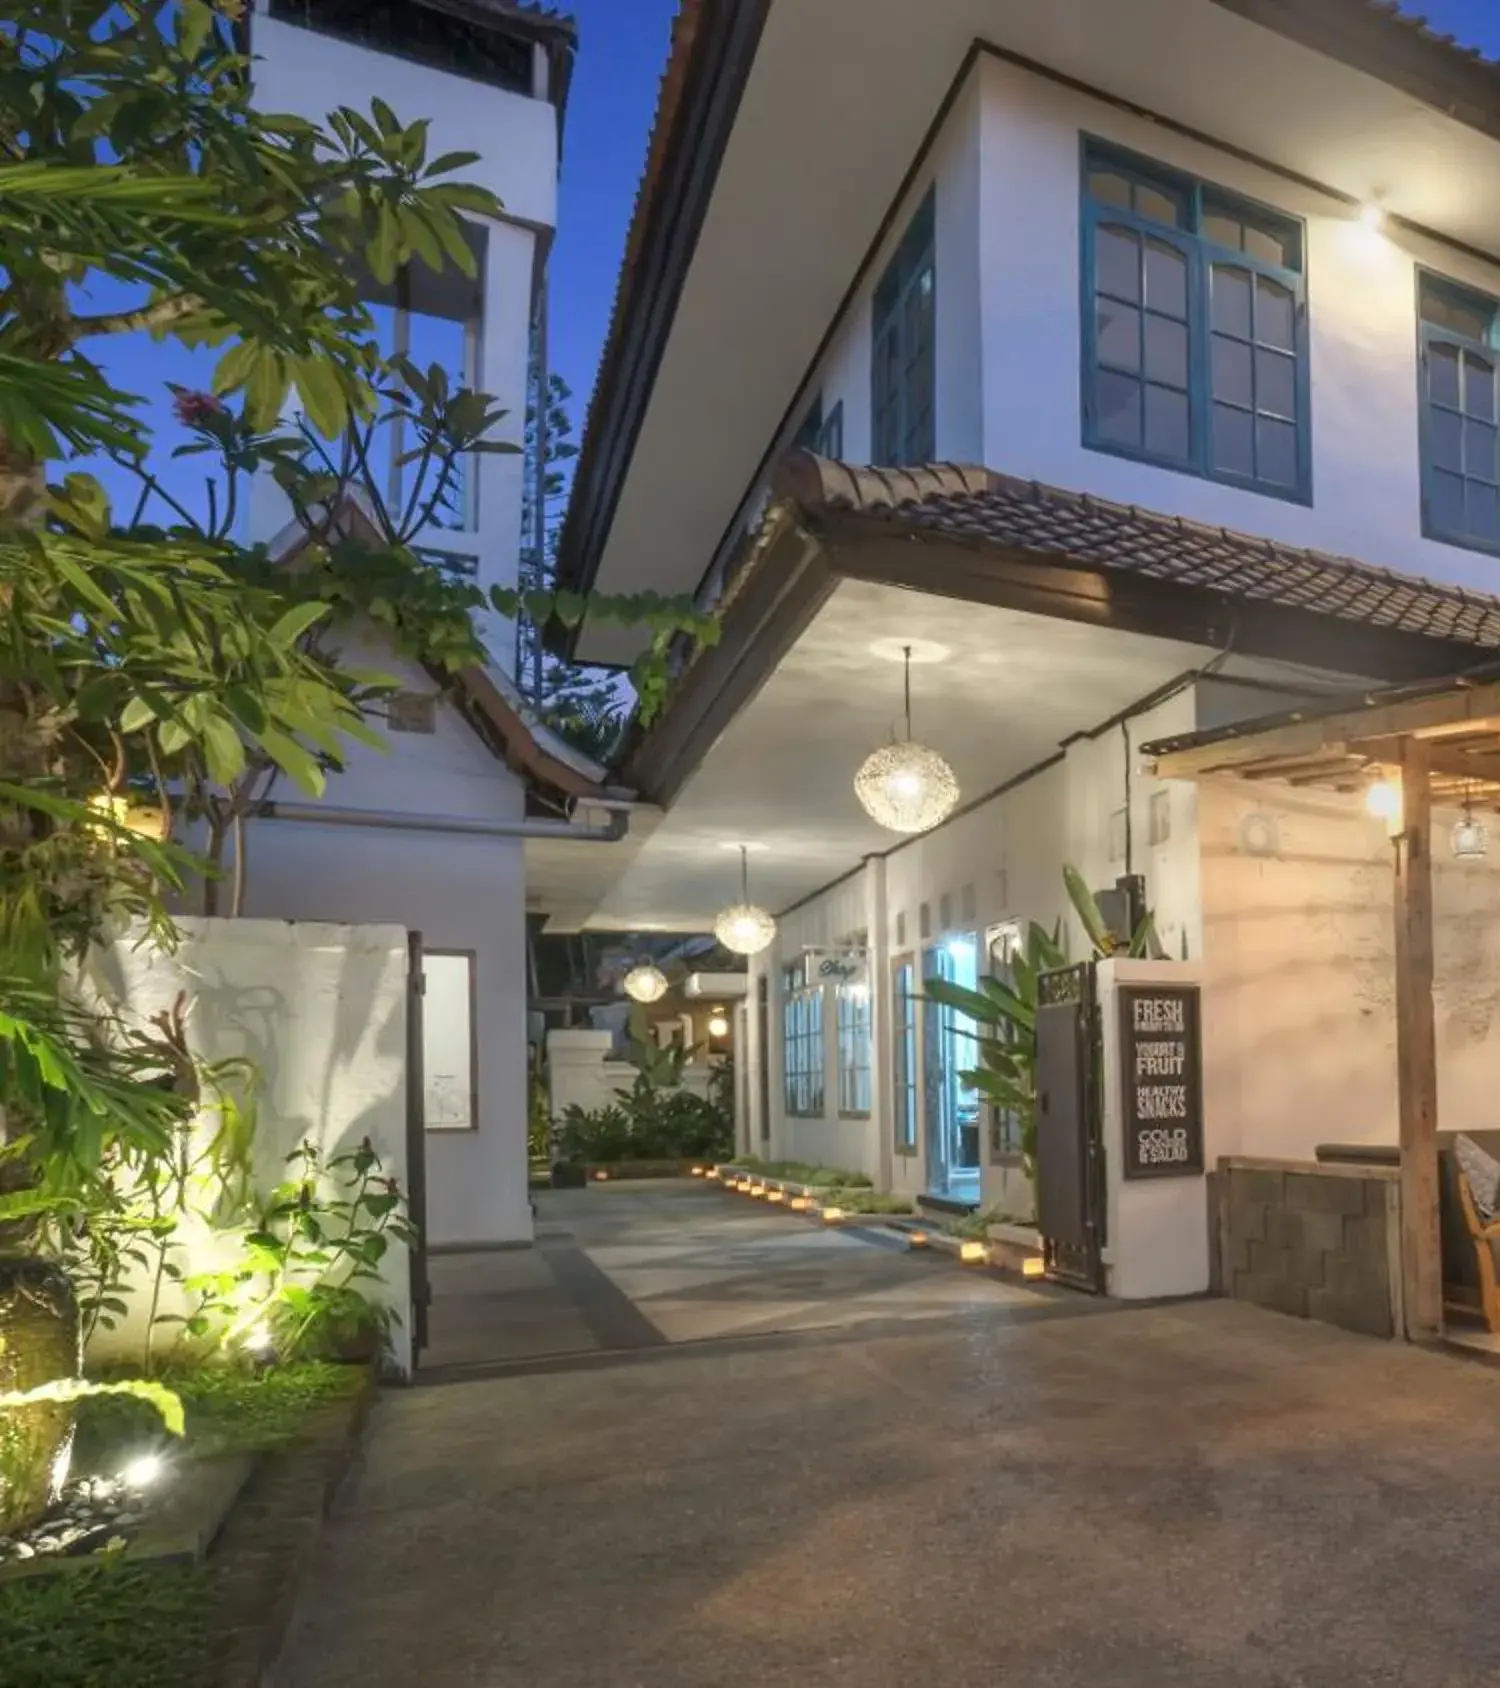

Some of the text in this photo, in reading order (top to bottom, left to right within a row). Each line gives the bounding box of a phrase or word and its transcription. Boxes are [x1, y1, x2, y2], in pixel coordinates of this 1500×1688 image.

[1134, 998, 1183, 1022] FRESH
[1136, 1057, 1185, 1076] FRUIT
[1137, 1097, 1186, 1119] SNACKS
